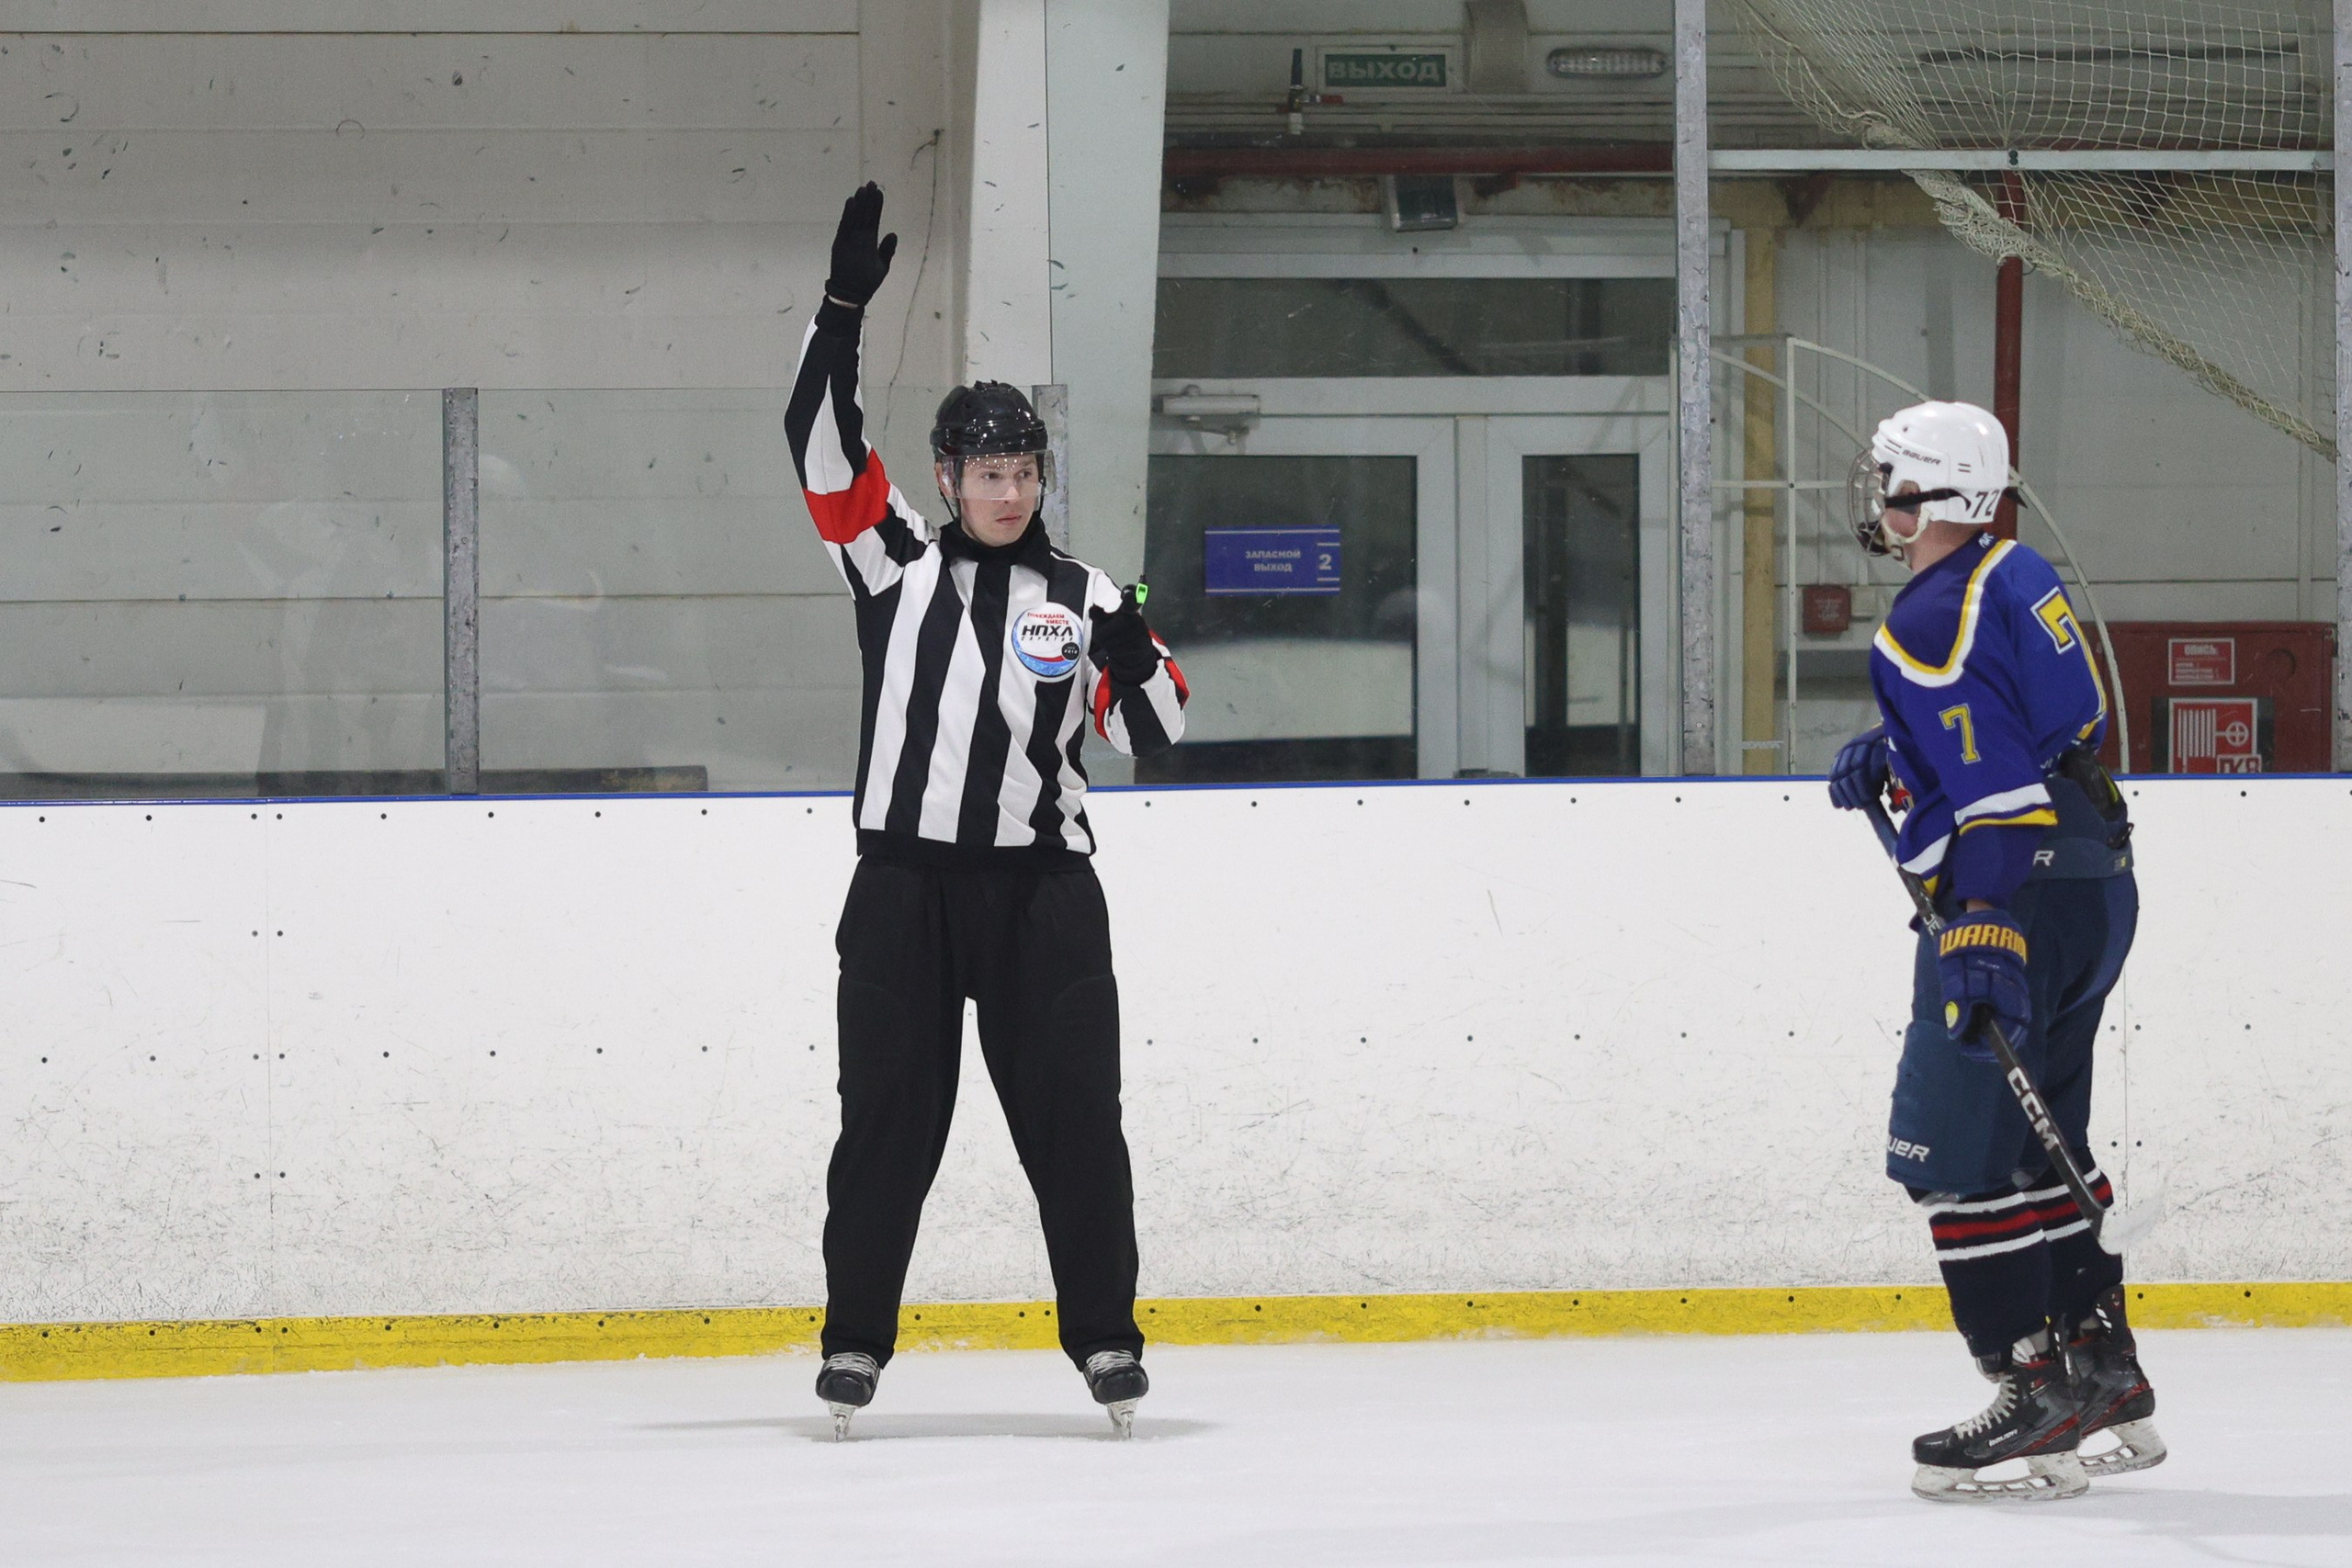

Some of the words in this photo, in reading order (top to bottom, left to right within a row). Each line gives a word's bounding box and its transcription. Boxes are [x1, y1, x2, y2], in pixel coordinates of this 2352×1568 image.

[1328, 61, 1440, 83] ВЫХОД
[1903, 449, 1941, 466] BAUER
[1971, 489, 2001, 519] 72
[1245, 549, 1302, 559] ЗАПАСНОЙ
[1318, 554, 1332, 570] 2
[1254, 563, 1293, 572] ВЫХОД
[1021, 625, 1074, 637] НПХЛ
[1939, 703, 1981, 764] 7
[2007, 1066, 2060, 1152] CCM
[1887, 1135, 1930, 1163] UER
